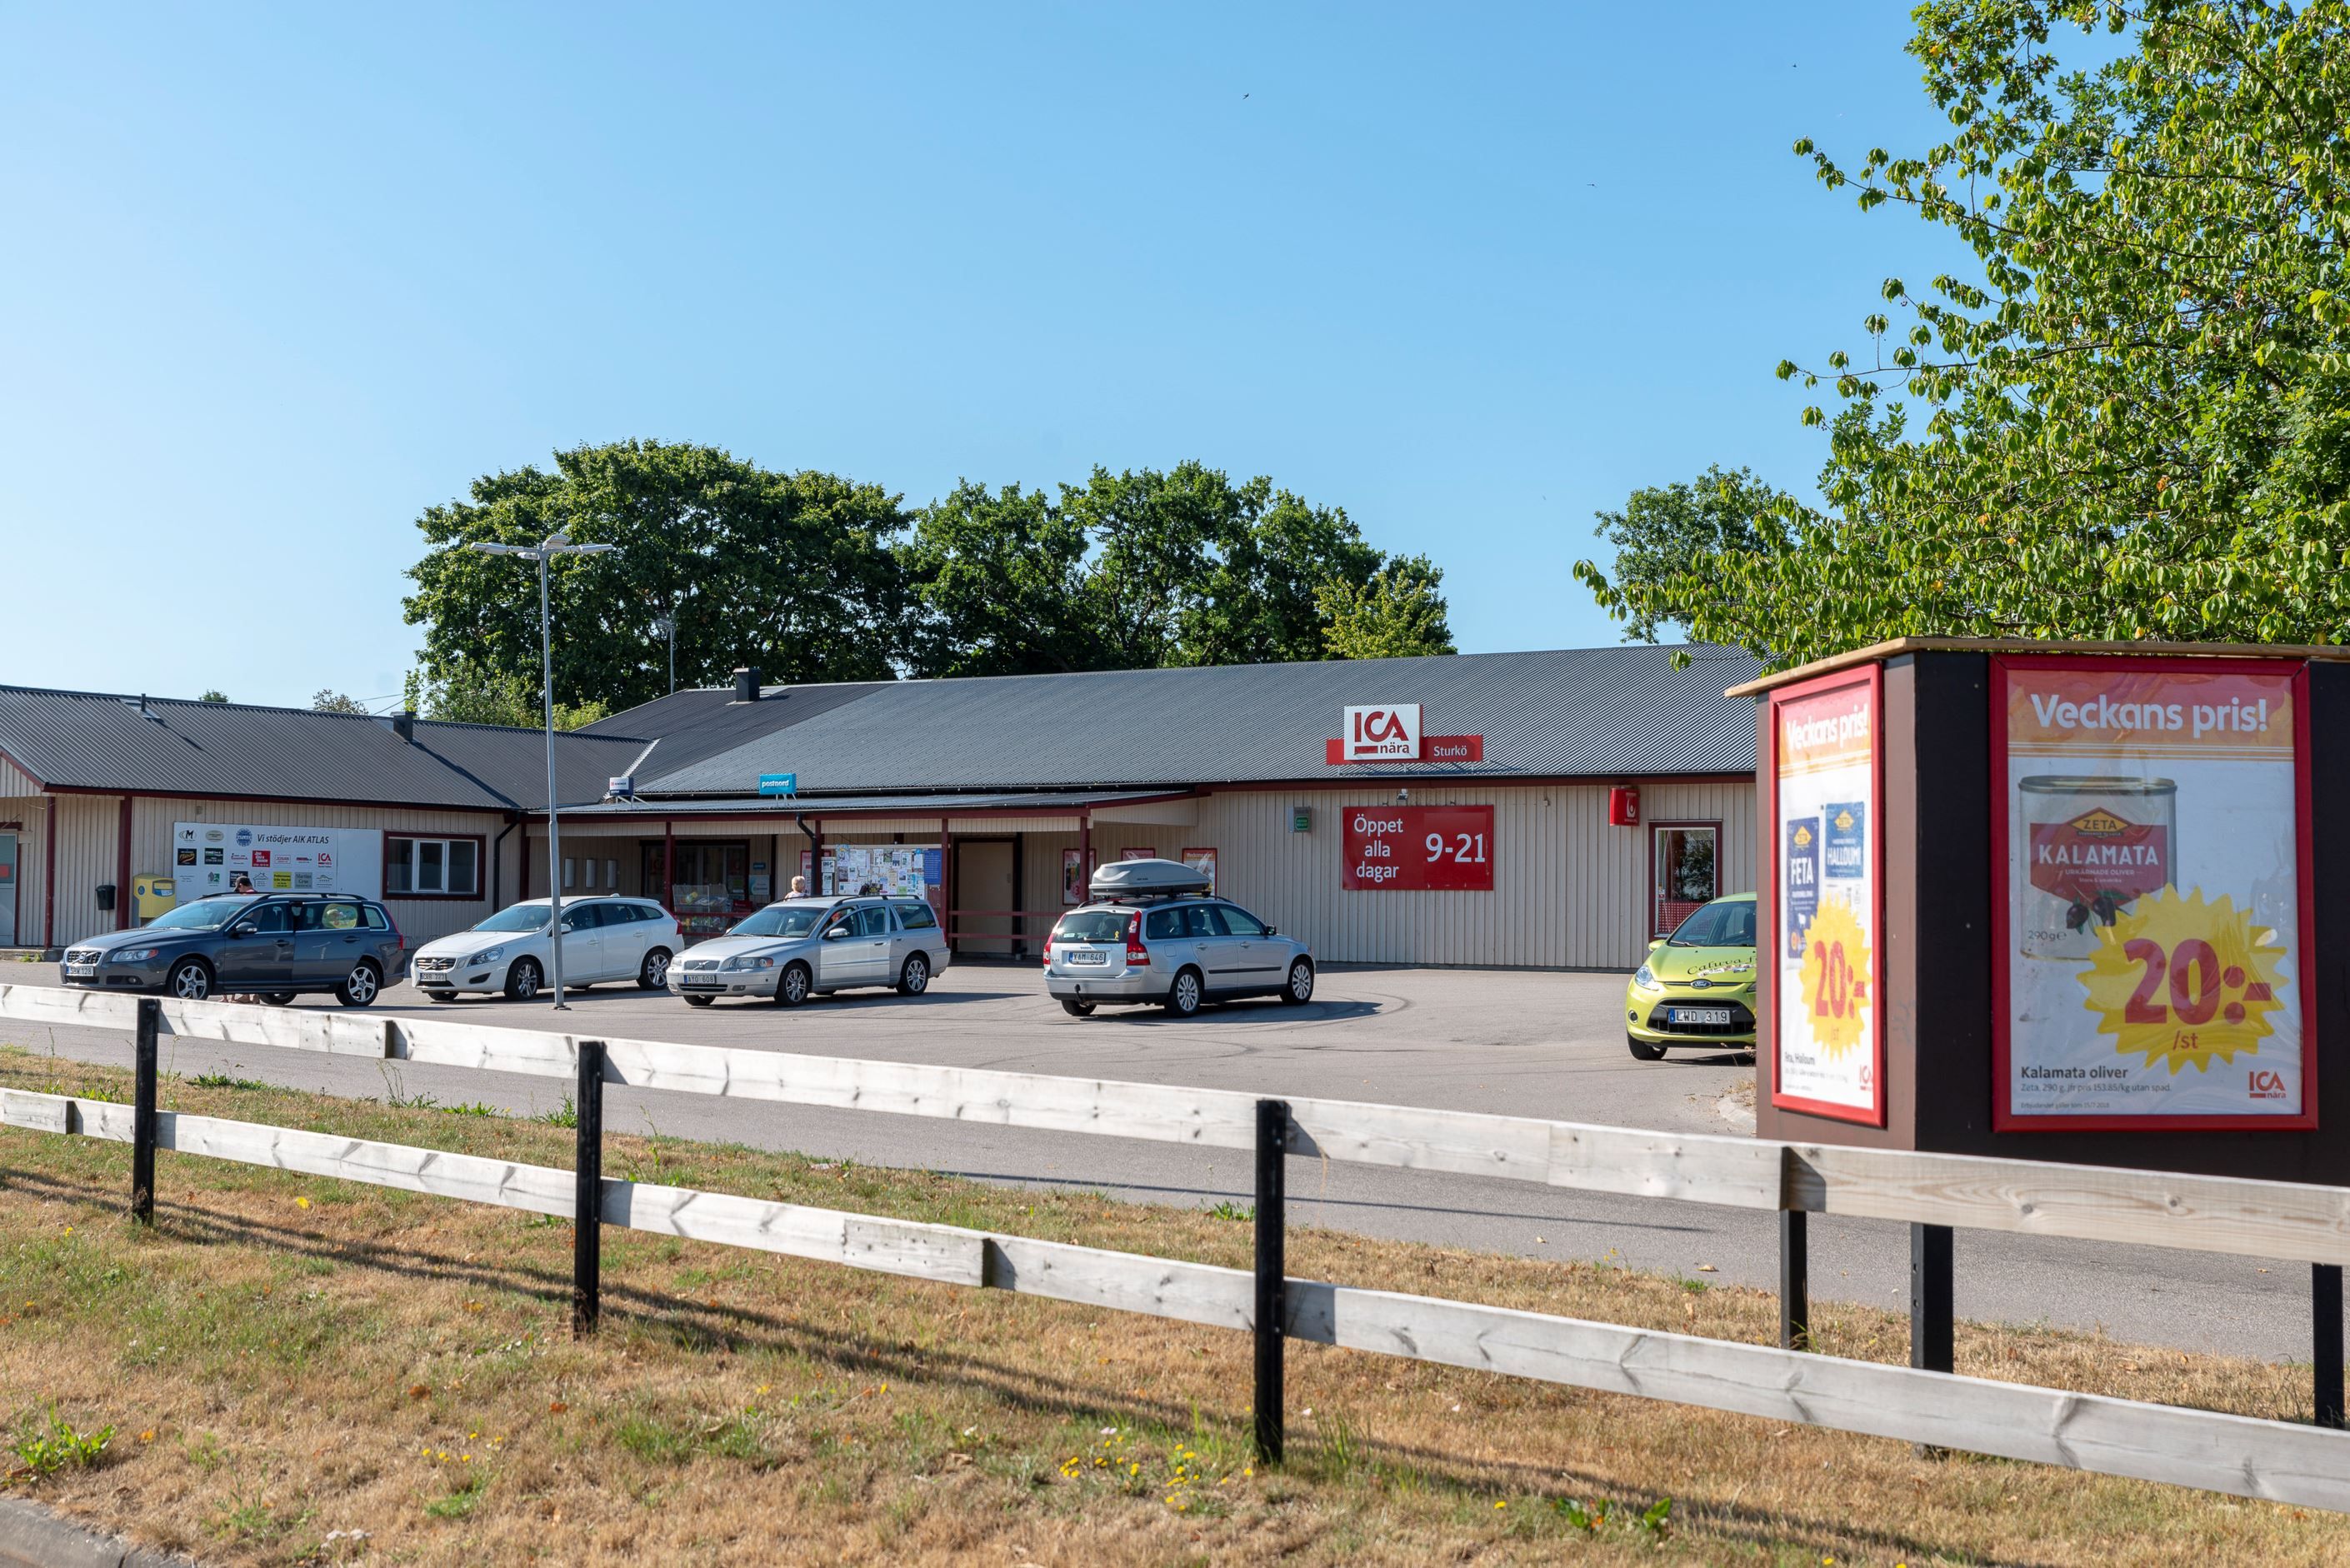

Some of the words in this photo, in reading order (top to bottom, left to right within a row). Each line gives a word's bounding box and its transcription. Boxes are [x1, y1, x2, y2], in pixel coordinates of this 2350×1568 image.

[2031, 694, 2183, 731] Veckans
[2192, 697, 2268, 739] pris!
[1354, 711, 1409, 742] ICA
[1786, 715, 1838, 750] Veckans
[1839, 703, 1869, 748] pris!
[1380, 742, 1409, 754] nära
[1433, 746, 1468, 757] Sturkö
[762, 780, 789, 788] postnord
[1354, 813, 1403, 836] Öppet
[2083, 819, 2118, 830] ZETA
[267, 835, 292, 845] stödjer
[306, 836, 329, 844] ATLAS
[1364, 840, 1391, 857] alla
[1426, 833, 1485, 862] 9-21
[318, 853, 332, 861] ICA
[2039, 845, 2158, 865] KALAMATA
[1356, 861, 1399, 883] dagar
[1791, 857, 1814, 885] FETA
[1073, 952, 1086, 961] XAM
[1814, 941, 1865, 1019] 20:-
[2122, 938, 2272, 1025] 20:-
[1676, 1011, 1698, 1021] LWD
[1706, 1011, 1728, 1021] 319
[2172, 1031, 2198, 1050] /st
[2021, 1066, 2085, 1079] Kalamata
[2089, 1066, 2128, 1079] oliver
[2249, 1071, 2285, 1091] ICA
[2042, 1083, 2058, 1091] 290
[2078, 1083, 2092, 1093] pris
